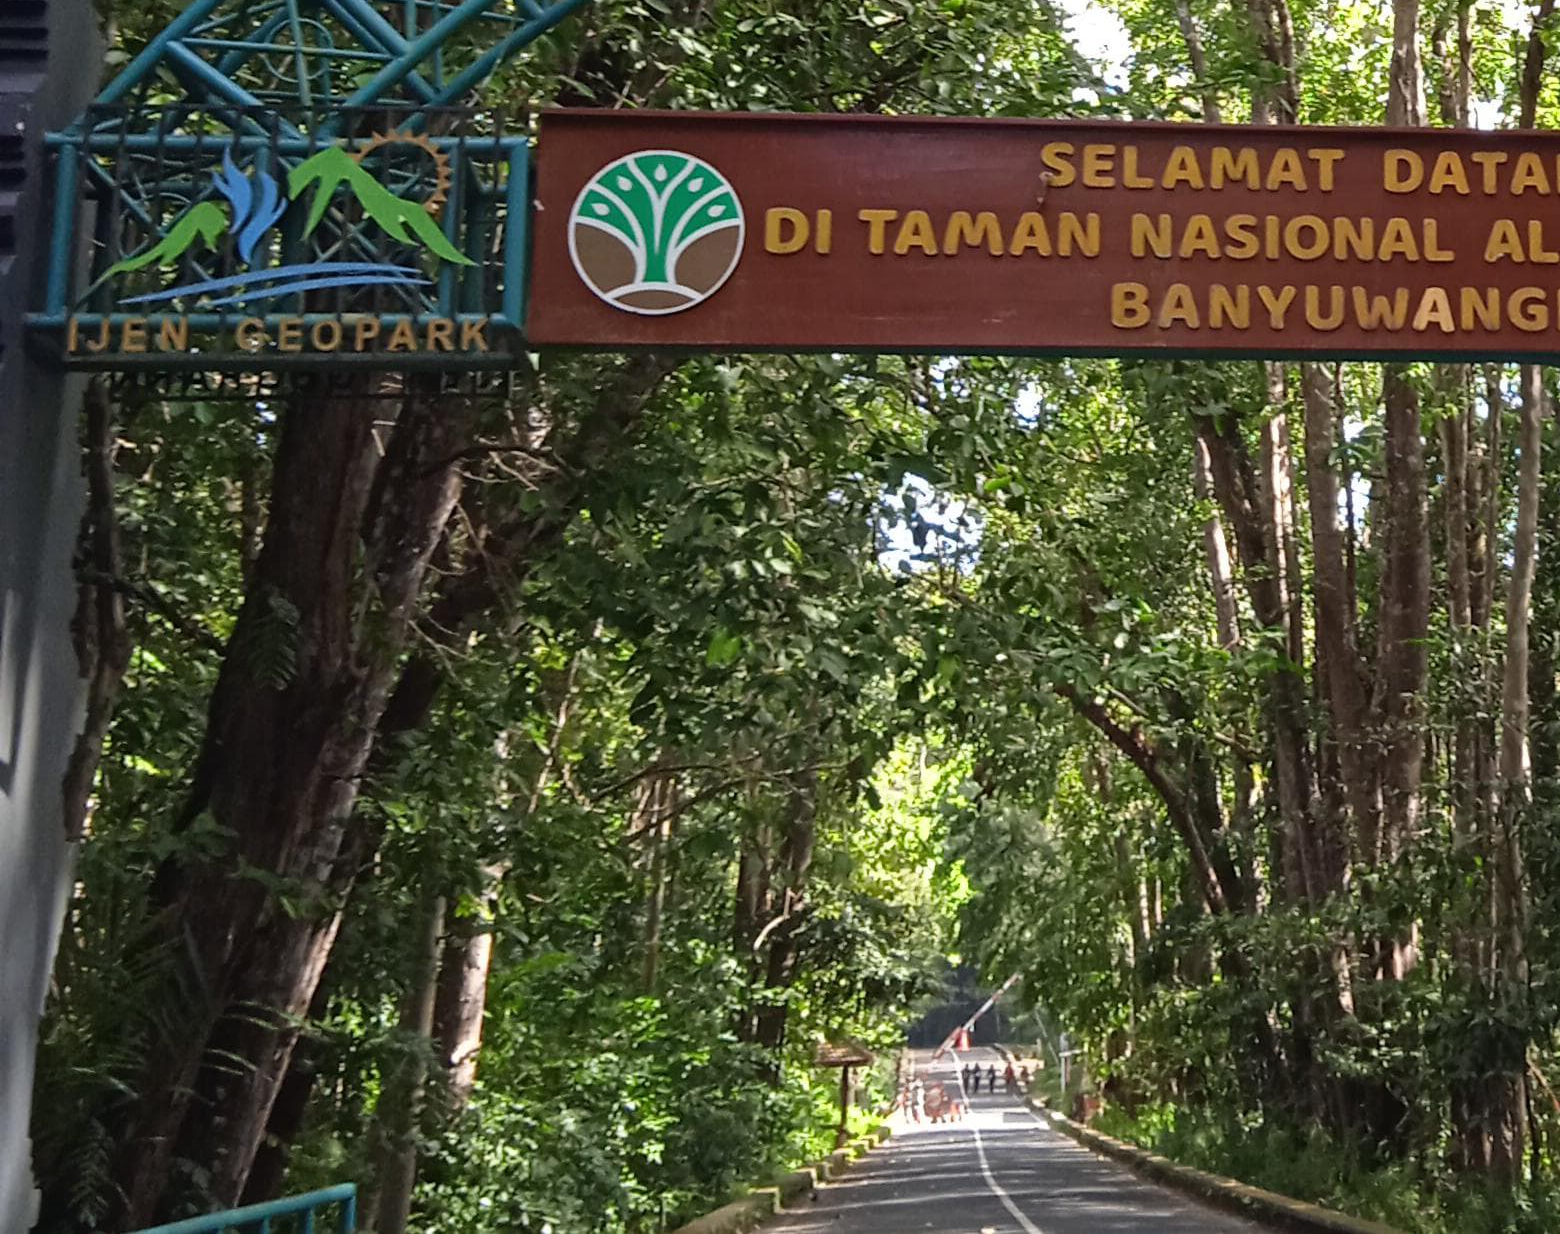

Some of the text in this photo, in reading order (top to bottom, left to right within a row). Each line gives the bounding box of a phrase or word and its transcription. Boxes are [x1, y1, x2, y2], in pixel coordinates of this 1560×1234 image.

[1040, 141, 1345, 193] SELAMAT
[763, 206, 832, 255] DI
[858, 209, 1101, 259] TAMAN
[1130, 213, 1455, 262] NASIONAL
[66, 317, 490, 352] IJEN GEOPARK
